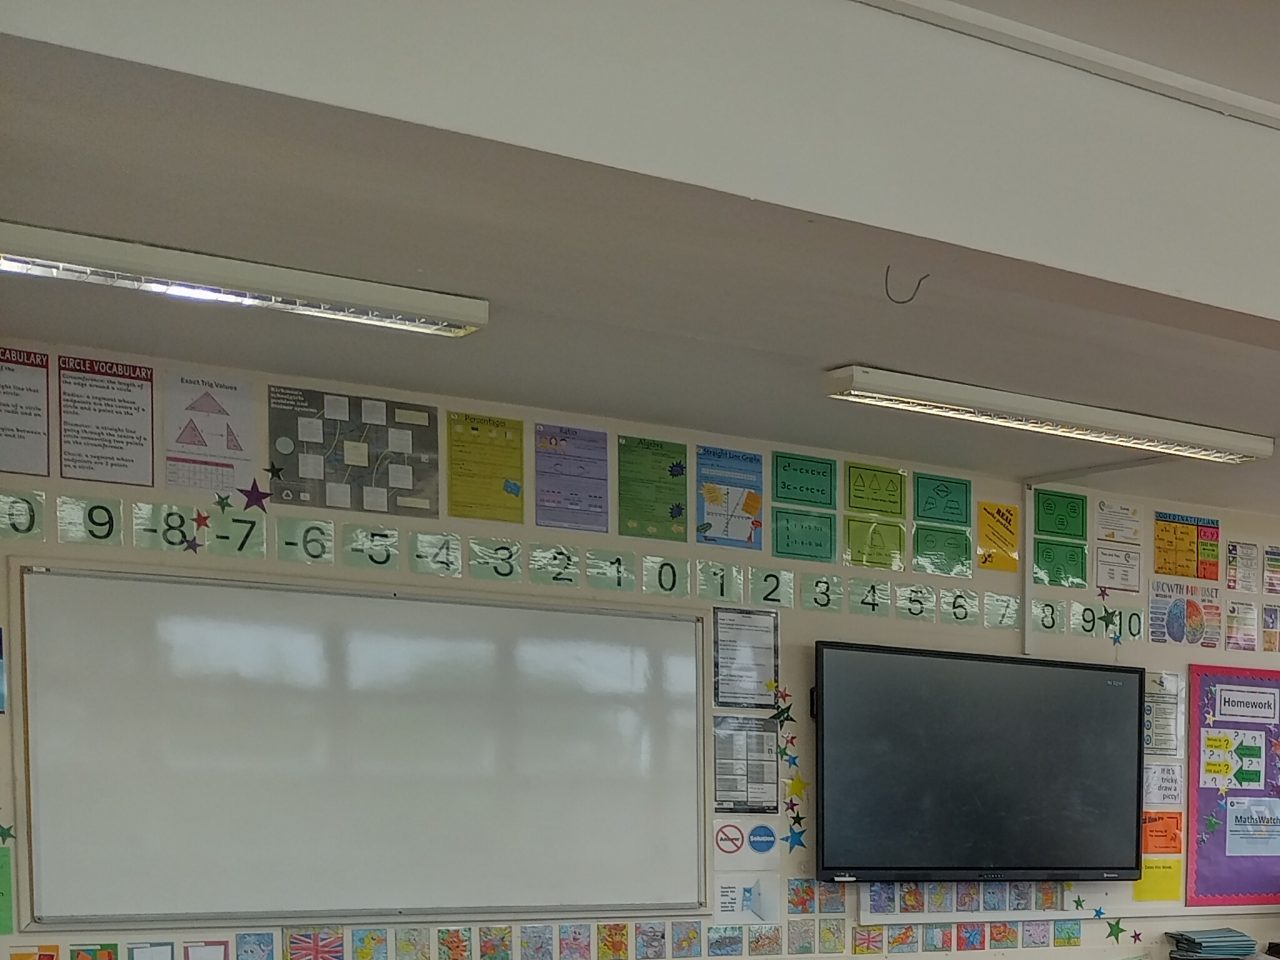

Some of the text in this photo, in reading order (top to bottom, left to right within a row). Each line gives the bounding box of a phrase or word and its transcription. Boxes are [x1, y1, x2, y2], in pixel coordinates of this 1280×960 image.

[60, 356, 152, 379] CIRCLE VOCABULARY
[703, 447, 727, 460] Straight
[216, 518, 257, 551] -7
[284, 526, 327, 559] -6
[657, 562, 678, 592] 0
[712, 568, 725, 597] 1
[763, 573, 782, 602] 2
[813, 580, 832, 608] 3
[860, 584, 880, 612] 4
[907, 589, 925, 616] 5
[951, 594, 969, 620] 6
[1081, 607, 1096, 633] 9
[1152, 581, 1184, 595] GROWTH
[1223, 696, 1273, 711] Homework
[1234, 815, 1280, 825] MathsWatch
